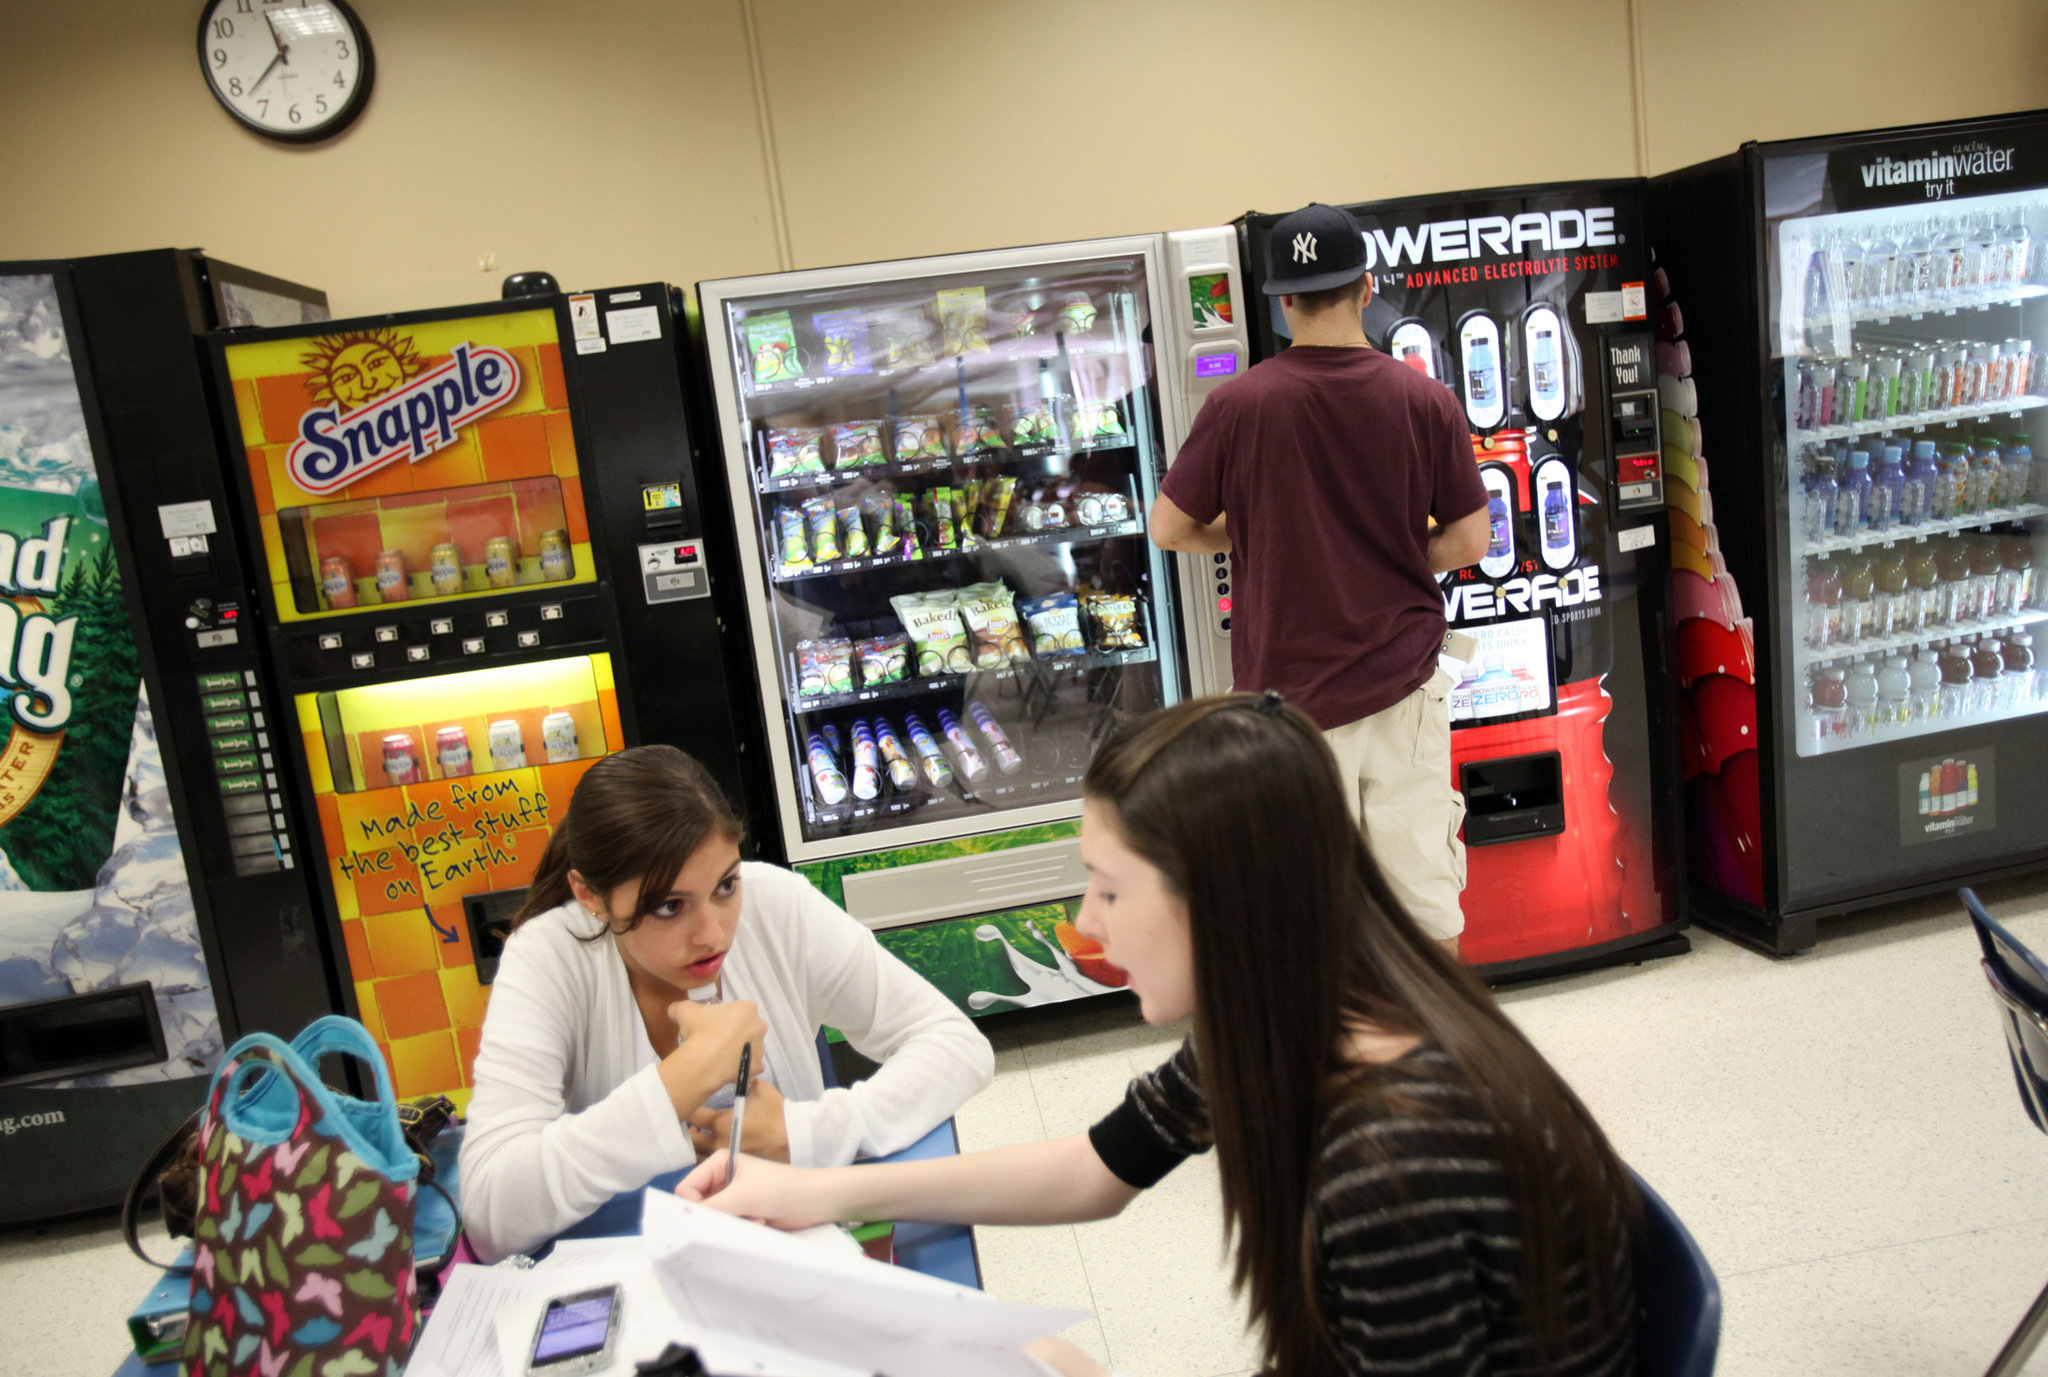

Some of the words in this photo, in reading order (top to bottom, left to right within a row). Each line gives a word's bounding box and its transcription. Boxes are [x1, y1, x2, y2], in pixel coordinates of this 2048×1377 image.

[213, 17, 234, 39] 10
[214, 49, 227, 69] 9
[336, 40, 349, 60] 3
[229, 77, 243, 97] 8
[333, 69, 346, 89] 4
[257, 99, 269, 119] 7
[288, 103, 301, 123] 6
[315, 94, 328, 114] 5
[1861, 146, 2015, 188] vitaminwater
[1925, 182, 1943, 200] try
[1945, 179, 1955, 195] it
[1292, 231, 1318, 264] NY
[1361, 207, 1617, 270] WERADE
[1406, 267, 1479, 289] ADVANCED
[1484, 257, 1570, 280] ELECTROLYTE
[1574, 253, 1619, 272] SYSTEM
[1610, 345, 1641, 366] Thank
[1615, 365, 1640, 385] You!
[302, 347, 503, 482] Snapple
[914, 609, 957, 628] Baked!
[1561, 608, 1585, 624] SPORTS
[1473, 690, 1519, 706] ZERO
[360, 801, 445, 840] Made
[451, 779, 520, 810] from
[339, 850, 394, 880] the
[397, 823, 464, 863] best
[474, 792, 549, 840] stuff
[385, 878, 416, 900] on
[420, 842, 516, 890] Earth.
